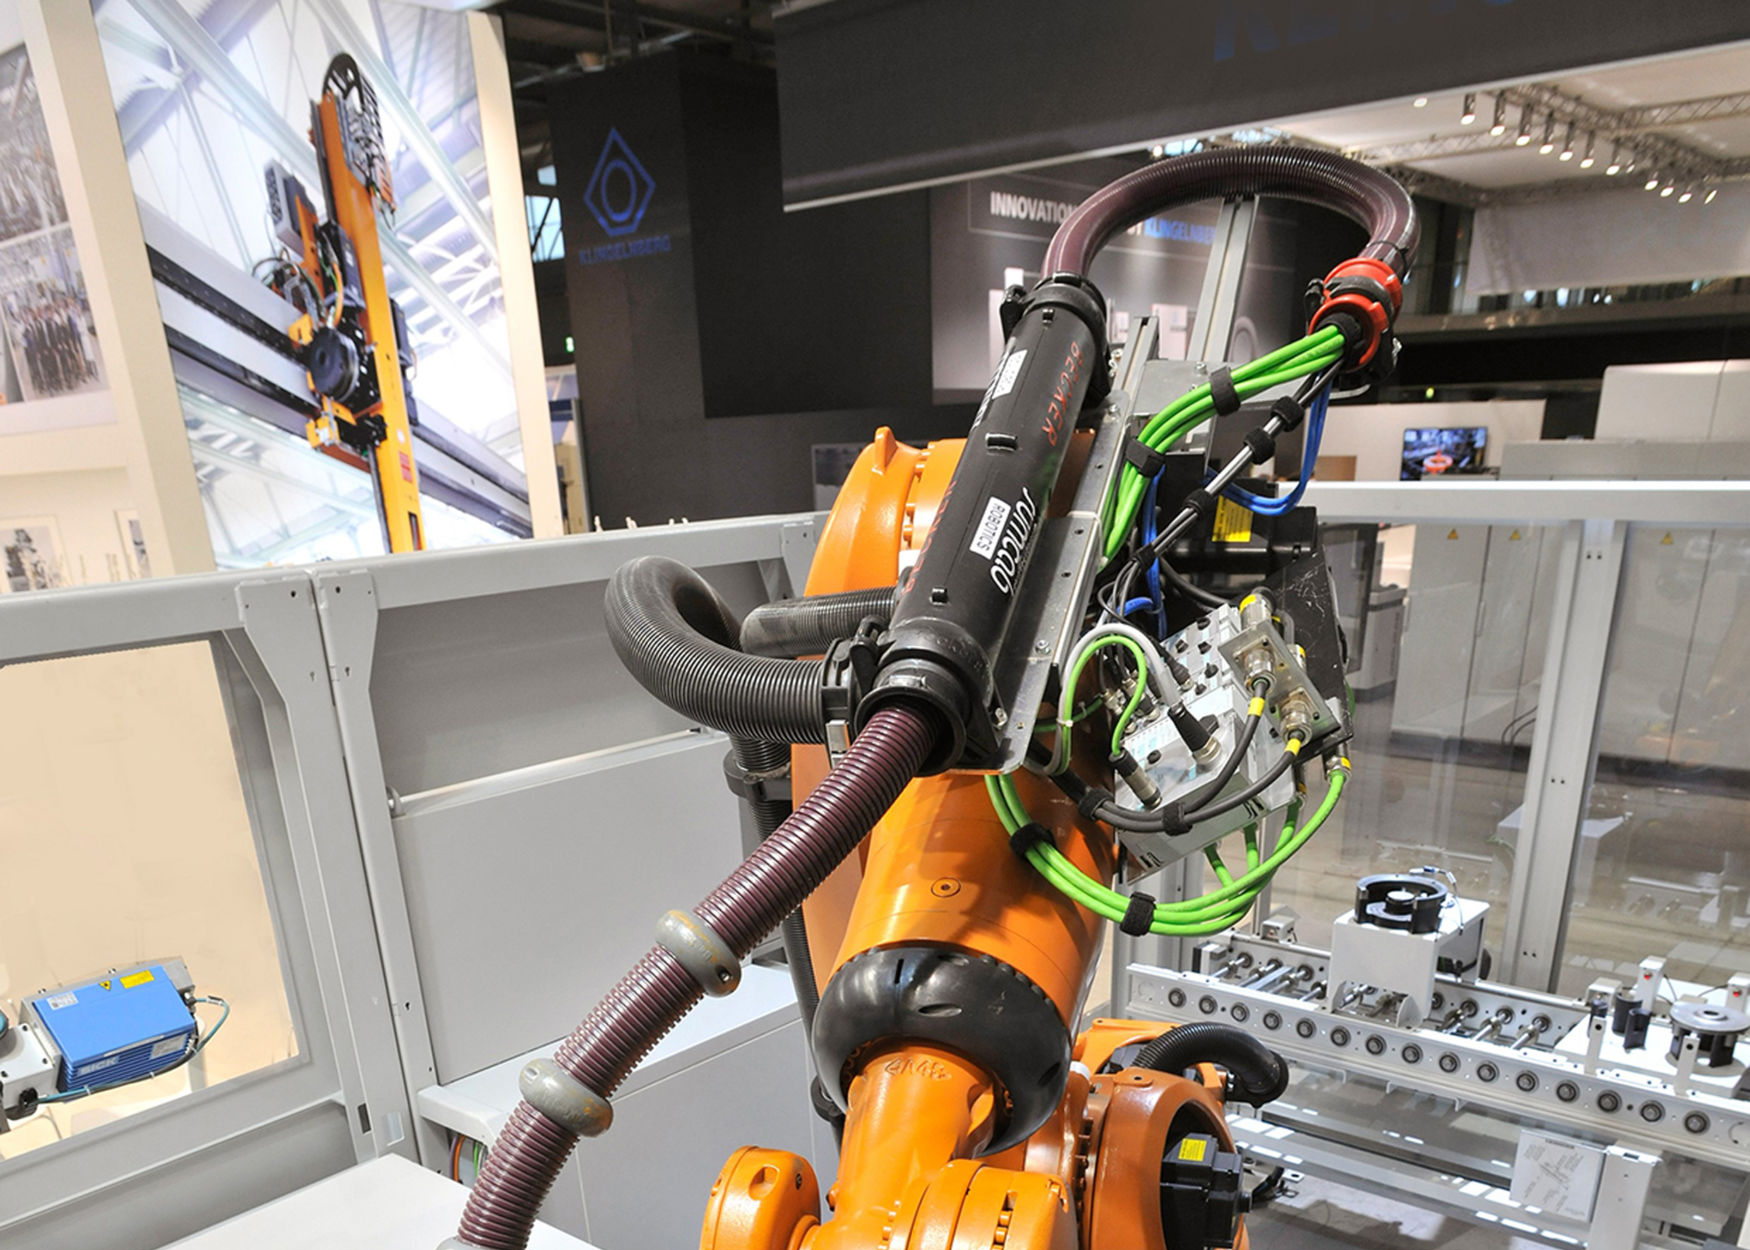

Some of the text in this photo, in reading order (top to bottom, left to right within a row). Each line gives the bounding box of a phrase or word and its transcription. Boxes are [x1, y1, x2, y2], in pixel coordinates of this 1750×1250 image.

[1041, 341, 1084, 447] BECKER
[977, 502, 1006, 552] ROBOTICS
[80, 1056, 118, 1075] SICK
